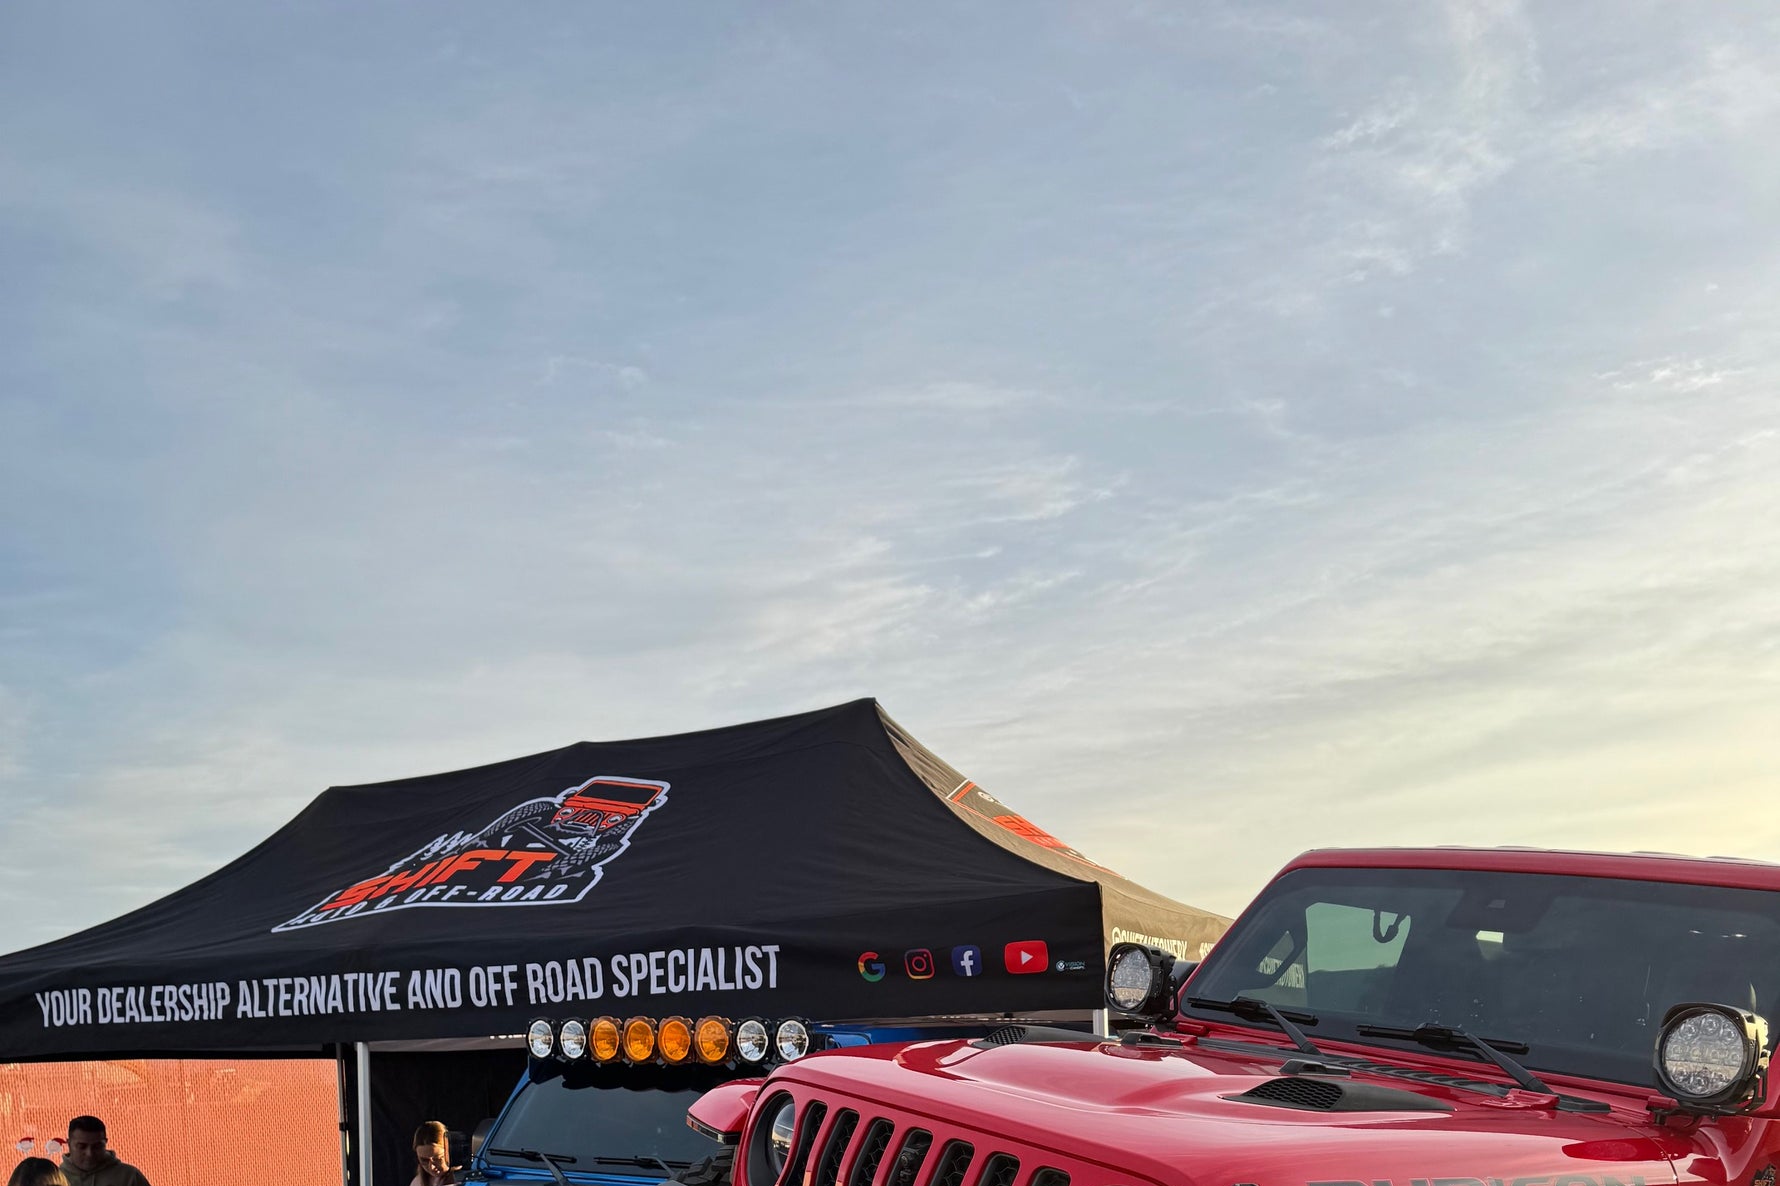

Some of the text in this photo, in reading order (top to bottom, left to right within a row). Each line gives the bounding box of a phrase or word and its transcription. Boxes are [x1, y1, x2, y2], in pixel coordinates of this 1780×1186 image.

[319, 850, 558, 910] SHIFT
[403, 884, 568, 903] OFF-ROAD
[35, 944, 781, 1028] YOUR DEALERSHIP ALTERNATIVE AND OFF ROAD SPECIALIST
